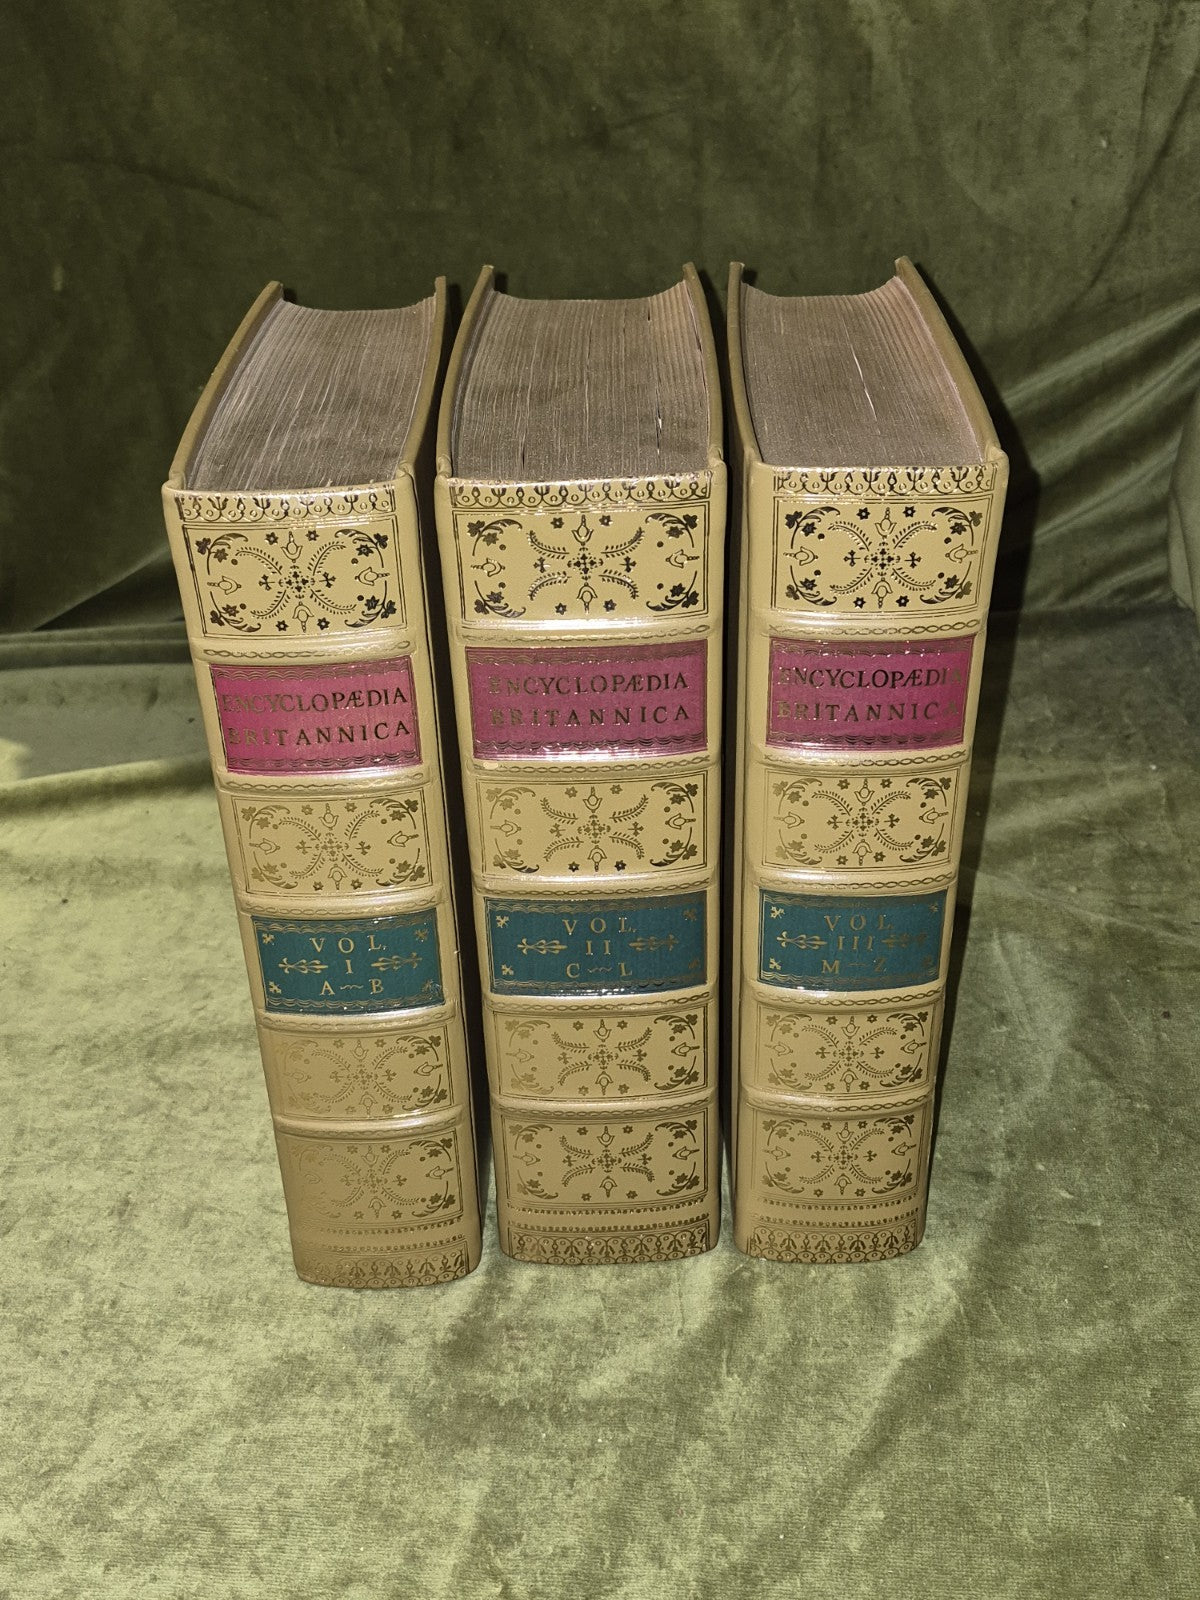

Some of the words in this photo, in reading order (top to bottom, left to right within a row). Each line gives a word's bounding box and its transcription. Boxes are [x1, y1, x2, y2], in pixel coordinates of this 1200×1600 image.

[491, 705, 690, 726] BRITANNICA
[777, 700, 959, 721] BRITANNICA
[227, 720, 410, 746] BRITANNICA
[585, 939, 611, 955] II
[837, 935, 874, 951] III
